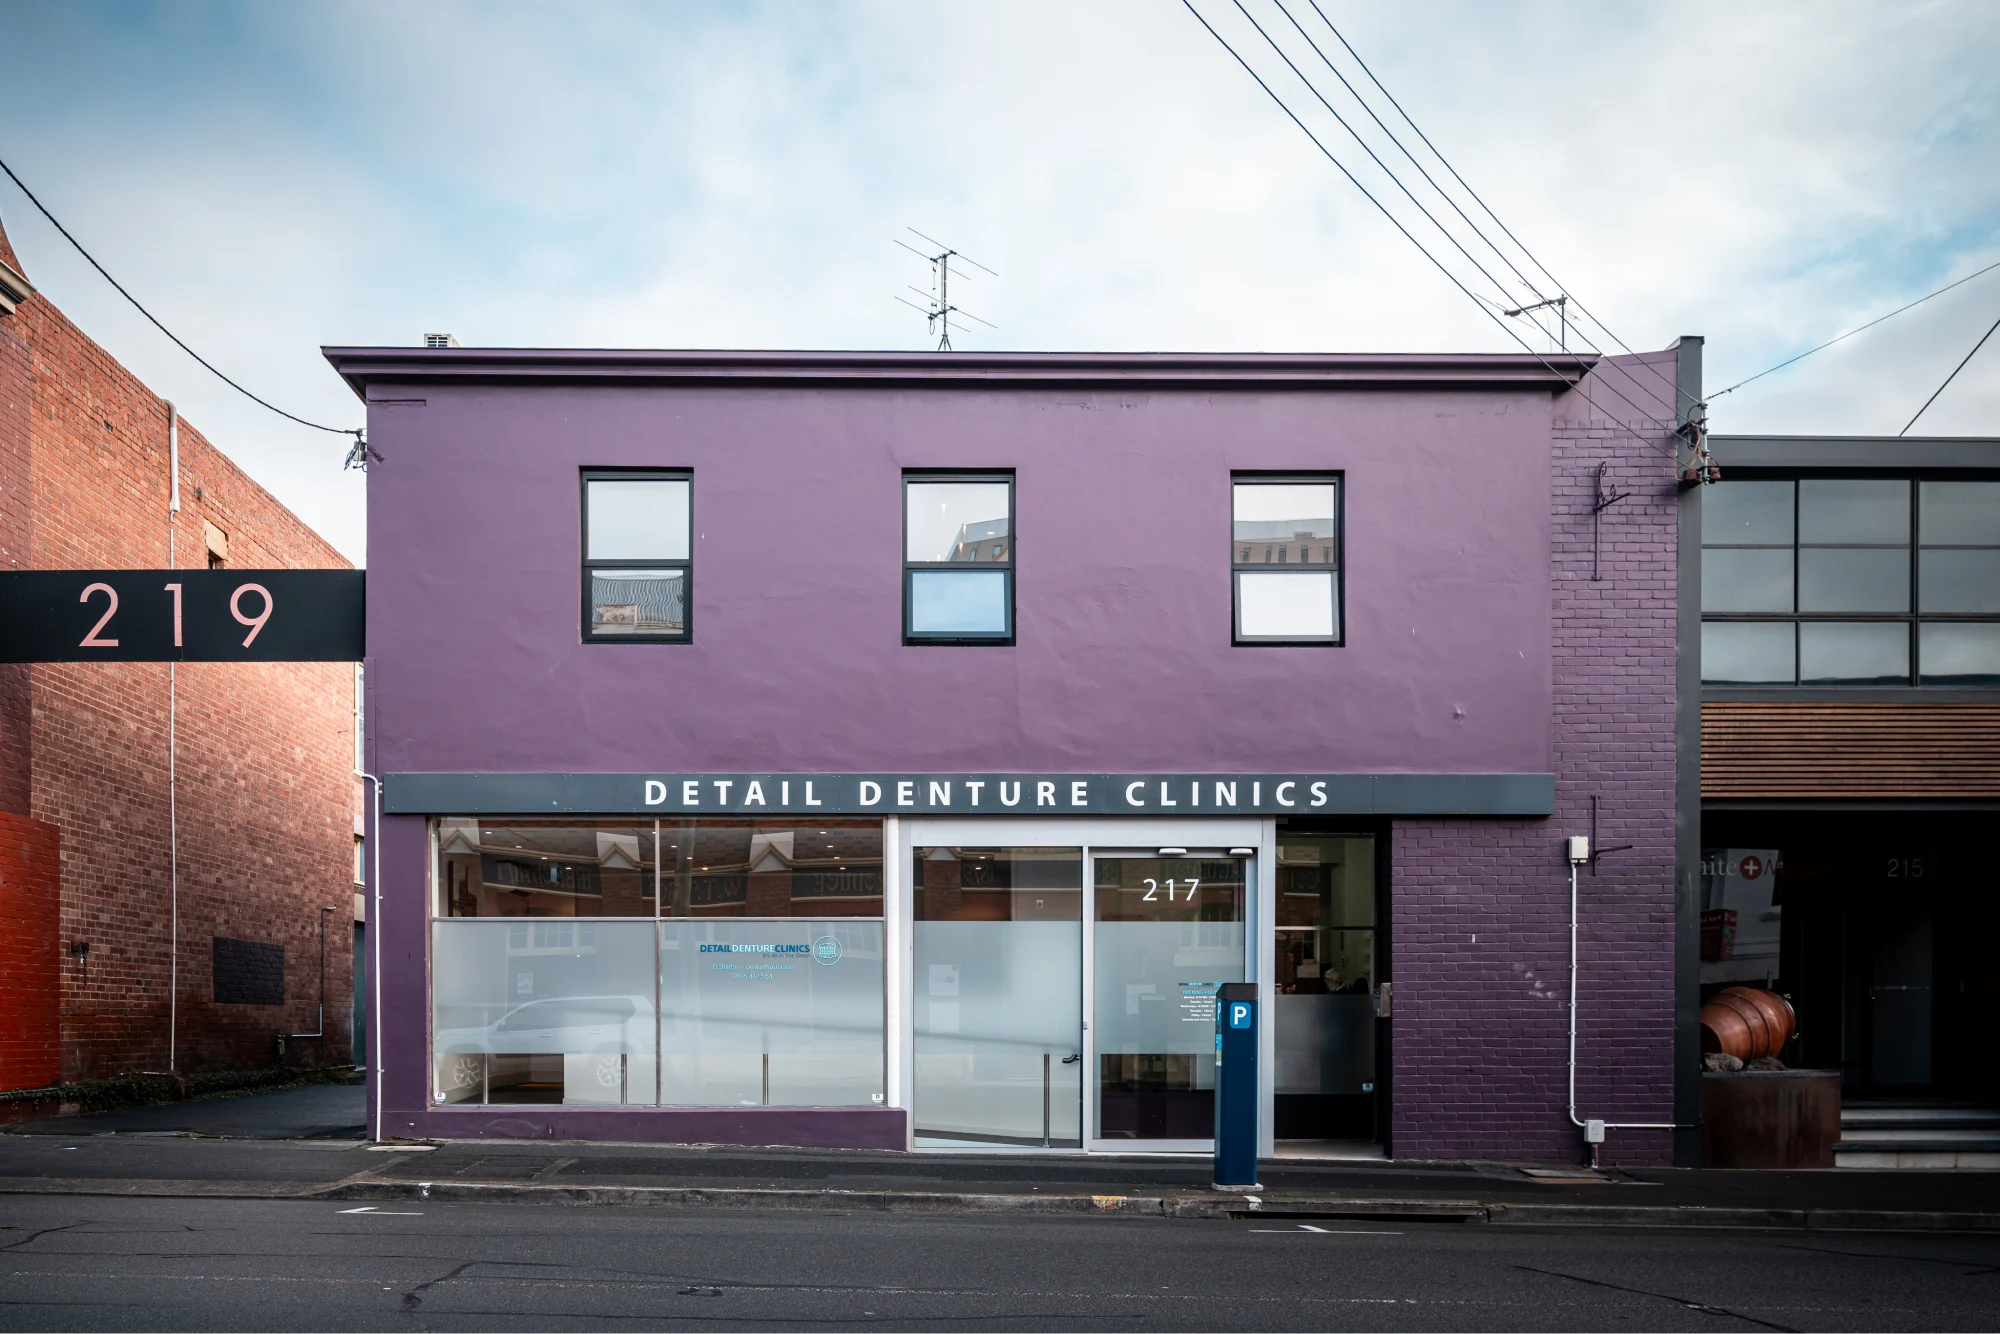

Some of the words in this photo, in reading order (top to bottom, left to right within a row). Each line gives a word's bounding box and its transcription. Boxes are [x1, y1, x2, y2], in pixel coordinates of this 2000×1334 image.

[79, 582, 273, 648] 219
[645, 781, 821, 805] DETAIL
[860, 781, 1087, 806] DENTURE
[1126, 782, 1327, 806] CLINICS
[1887, 858, 1923, 878] 215
[1142, 878, 1199, 901] 217
[1234, 1006, 1247, 1025] P
